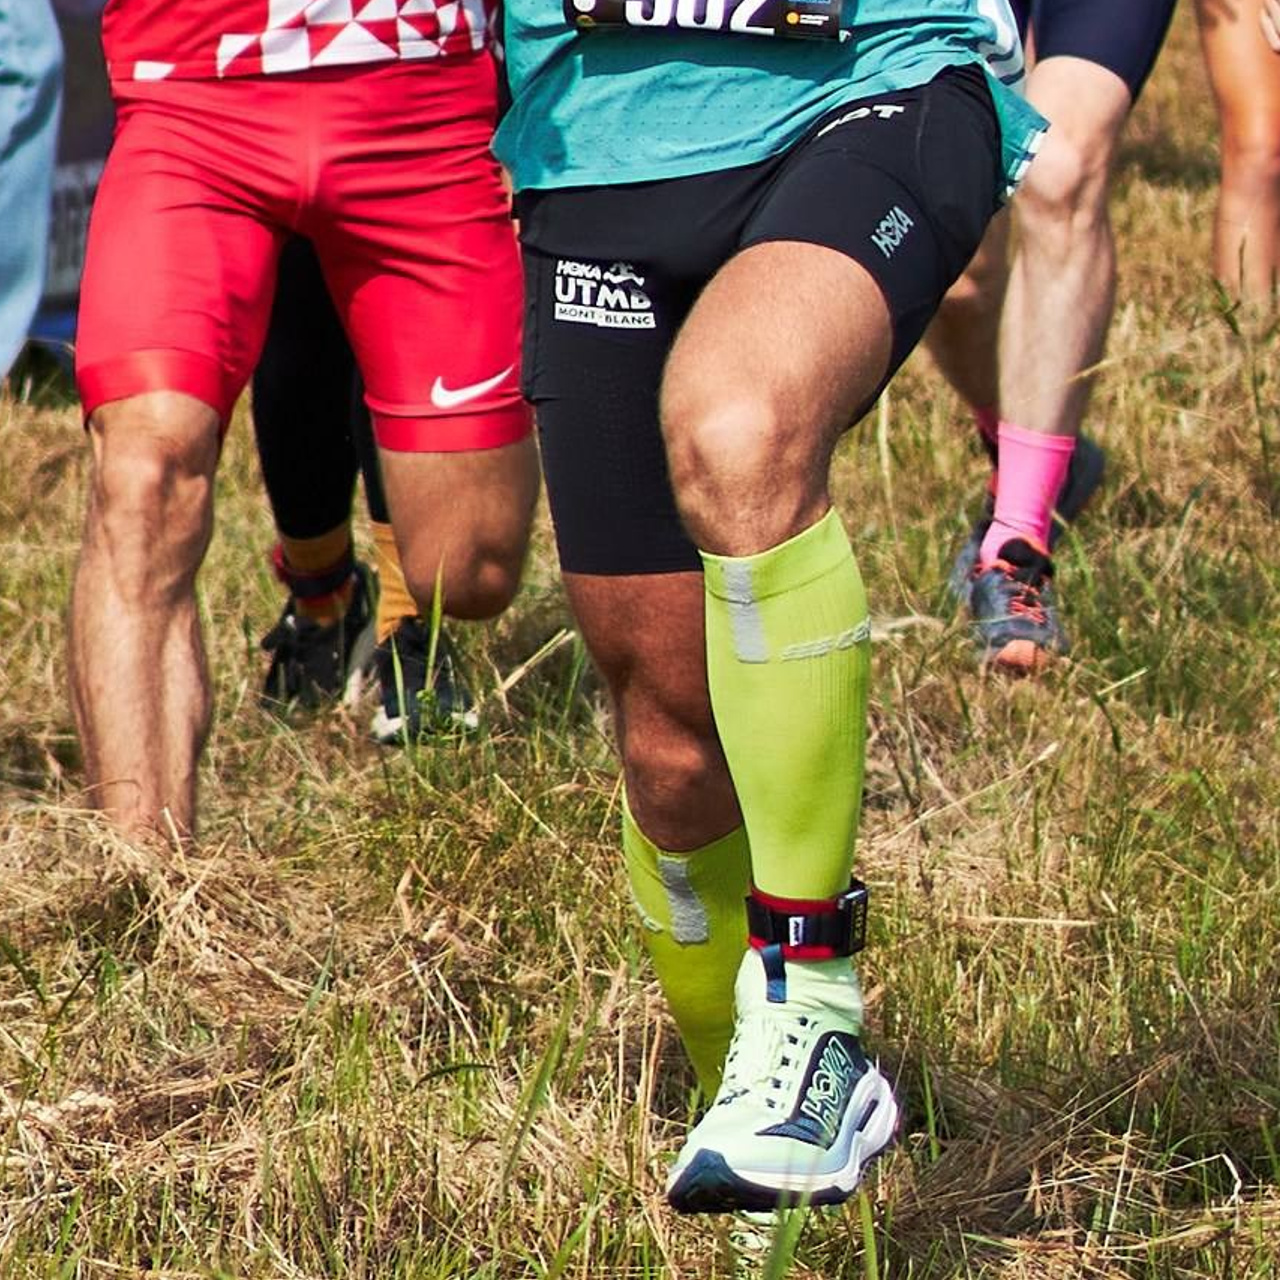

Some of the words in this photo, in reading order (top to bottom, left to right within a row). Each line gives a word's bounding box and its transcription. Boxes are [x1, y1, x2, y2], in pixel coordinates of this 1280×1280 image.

[871, 206, 914, 259] HOKA
[556, 260, 602, 281] HOKA
[555, 275, 652, 311] UTMB
[800, 1035, 854, 1138] HOKA
